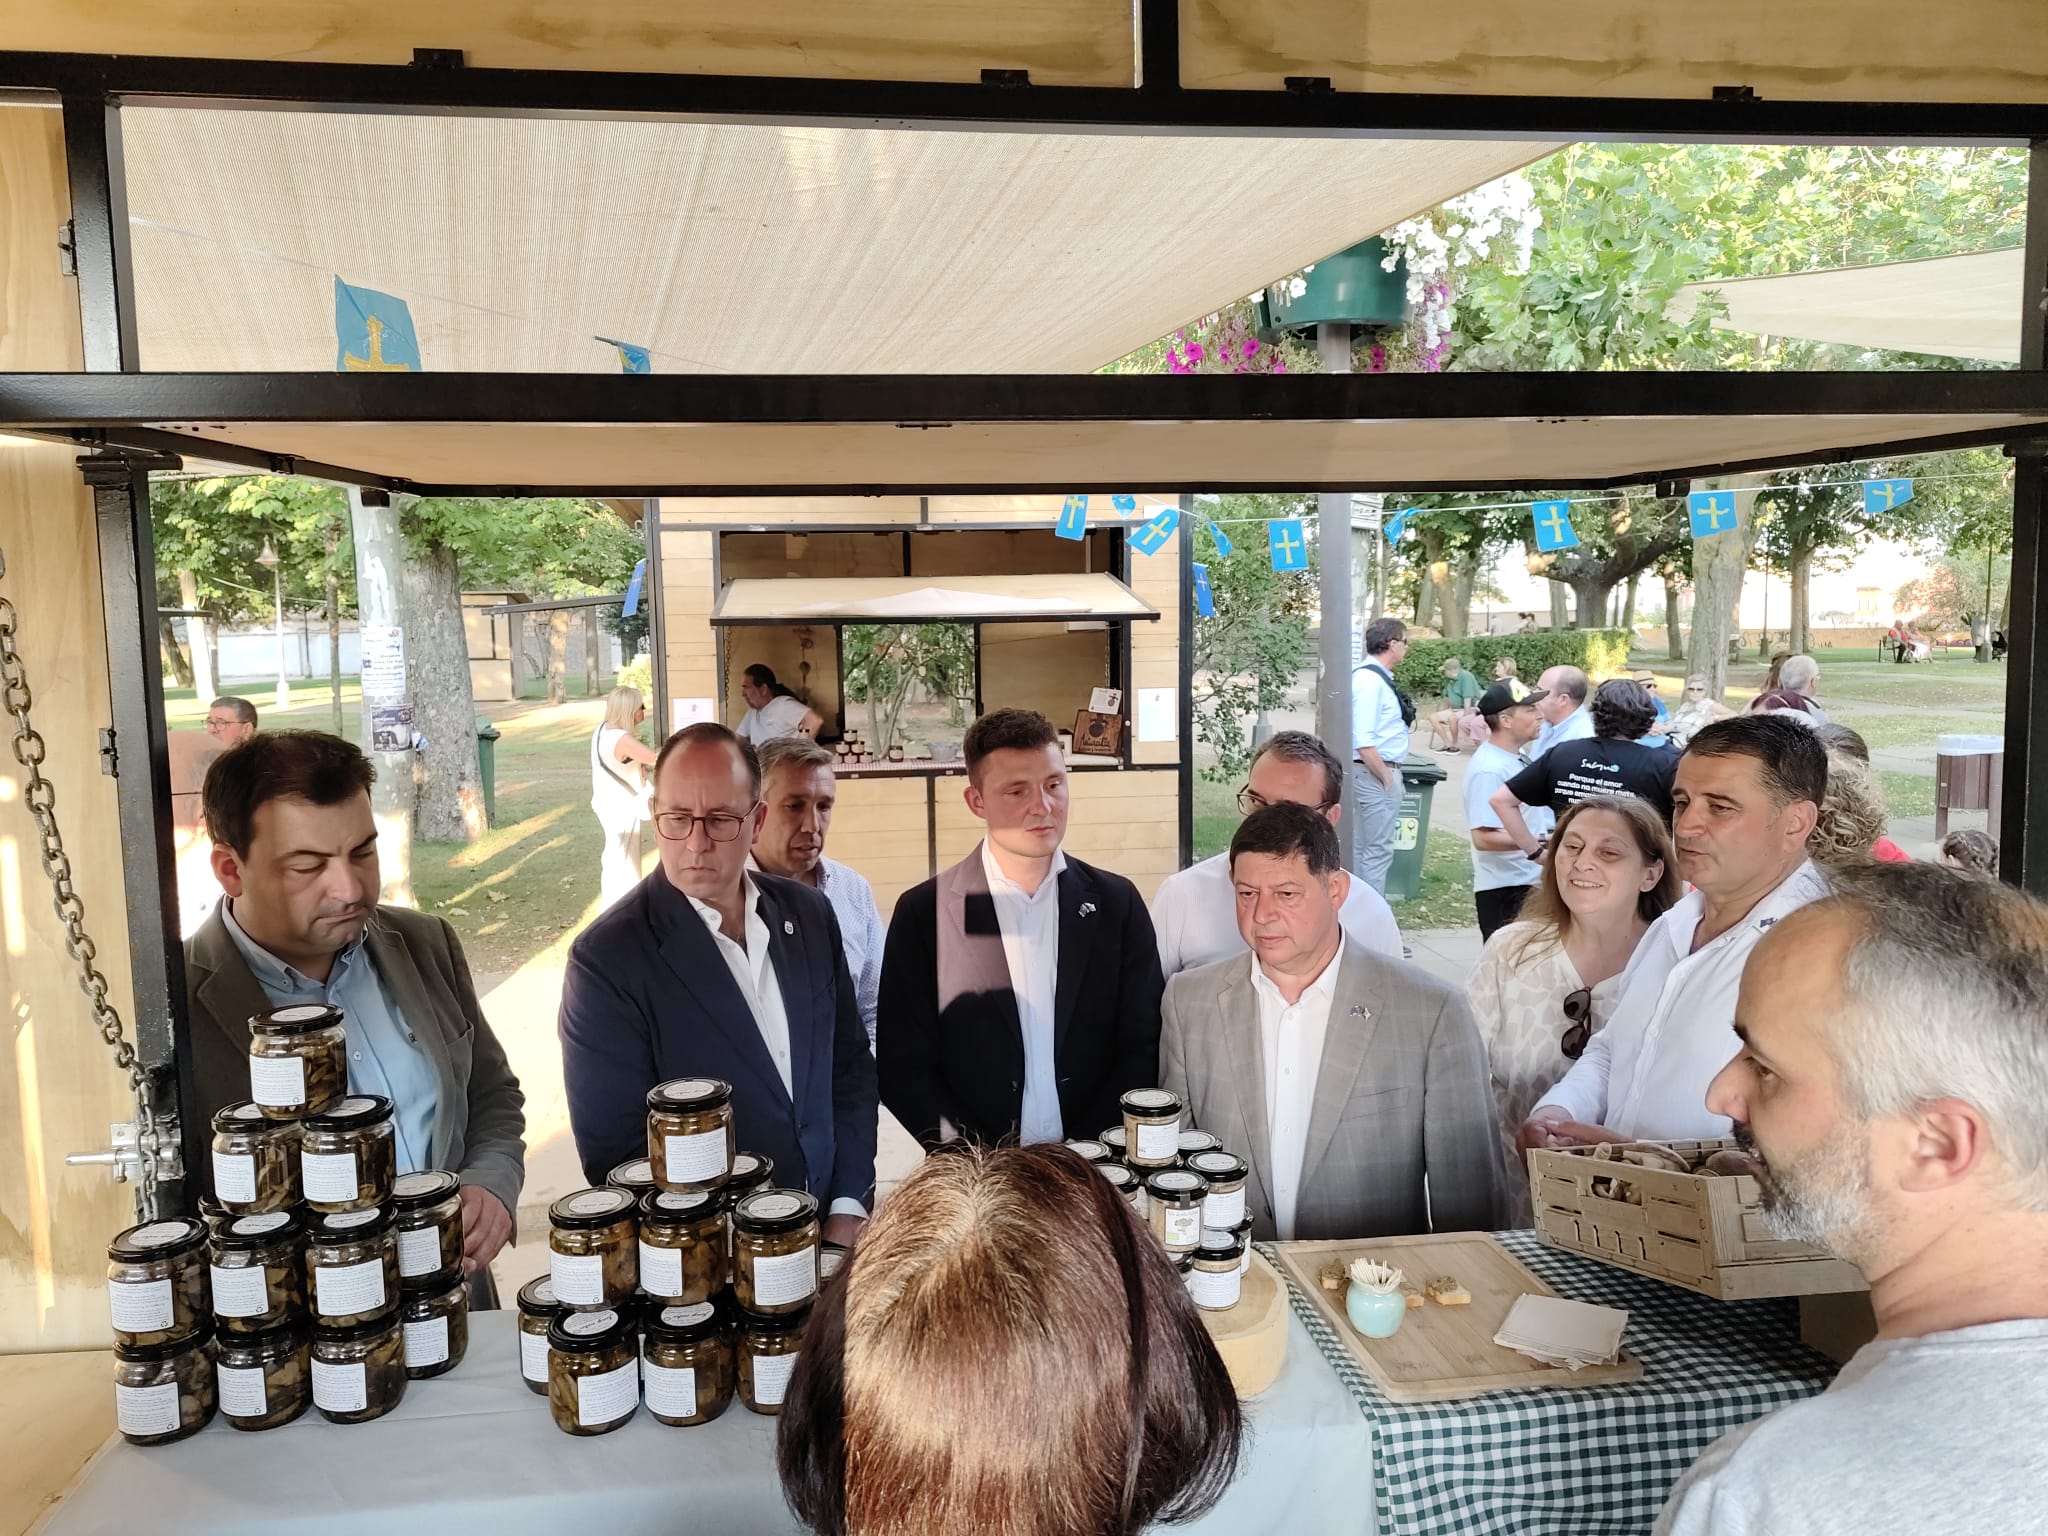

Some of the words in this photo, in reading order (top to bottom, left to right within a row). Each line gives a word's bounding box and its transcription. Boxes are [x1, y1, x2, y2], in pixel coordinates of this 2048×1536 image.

[1557, 780, 1580, 789] cuando
[1591, 786, 1615, 794] muere
[1569, 773, 1595, 784] Porque
[1595, 778, 1603, 786] el
[1603, 780, 1624, 788] amor
[1554, 787, 1573, 796] porque
